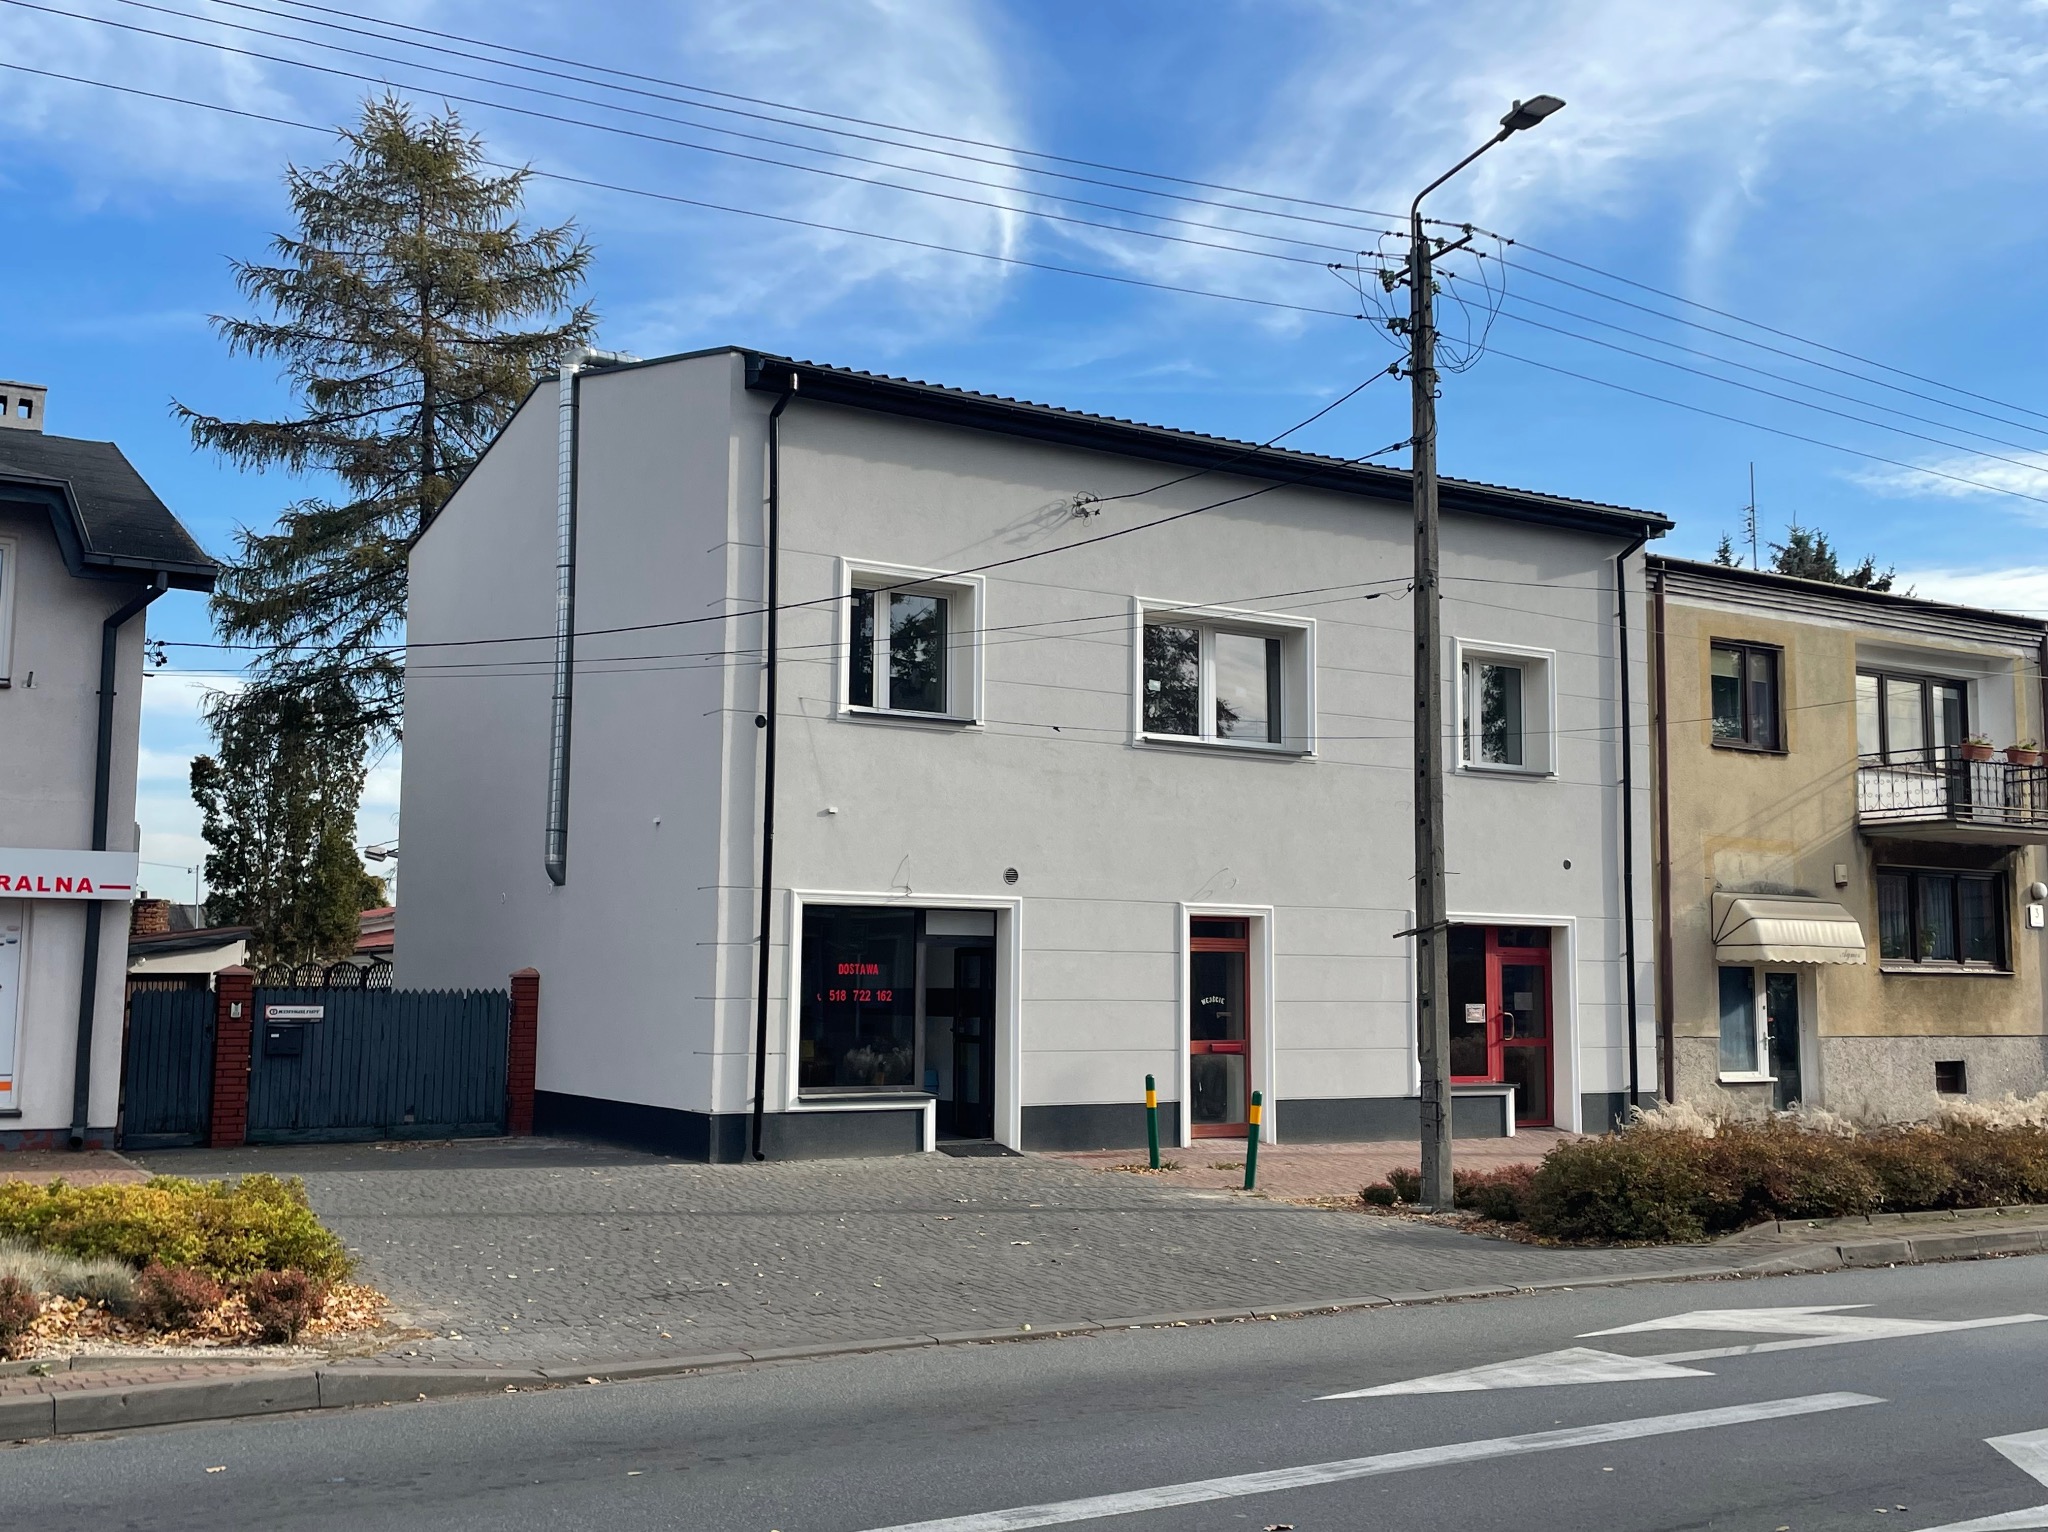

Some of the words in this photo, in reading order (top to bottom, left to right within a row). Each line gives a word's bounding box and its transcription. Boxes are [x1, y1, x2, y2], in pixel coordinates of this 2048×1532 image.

[0, 875, 93, 893] RALNA
[838, 963, 879, 975] DOSTAWA
[829, 989, 847, 1002] 518
[853, 989, 871, 1002] 722
[876, 990, 893, 1002] 162
